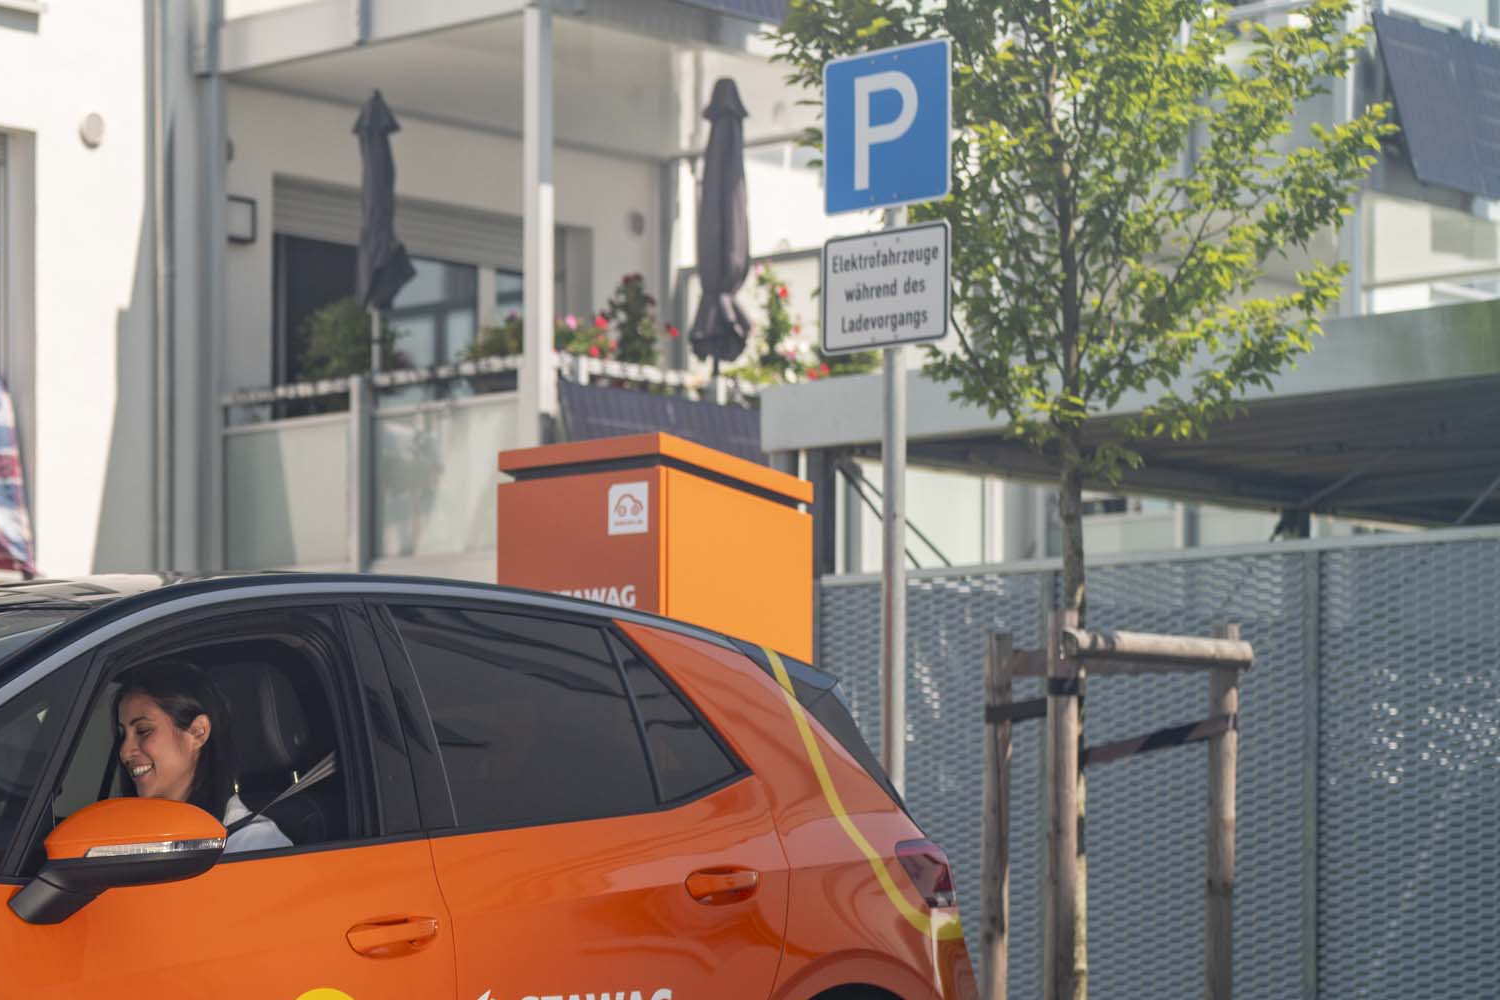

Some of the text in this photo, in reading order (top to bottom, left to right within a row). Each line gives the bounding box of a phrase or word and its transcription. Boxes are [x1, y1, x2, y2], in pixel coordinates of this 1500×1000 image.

[854, 71, 918, 191] P
[832, 244, 939, 275] Elektrofahrzeuge
[845, 277, 926, 303] während des
[841, 309, 928, 334] Ladevorgangs
